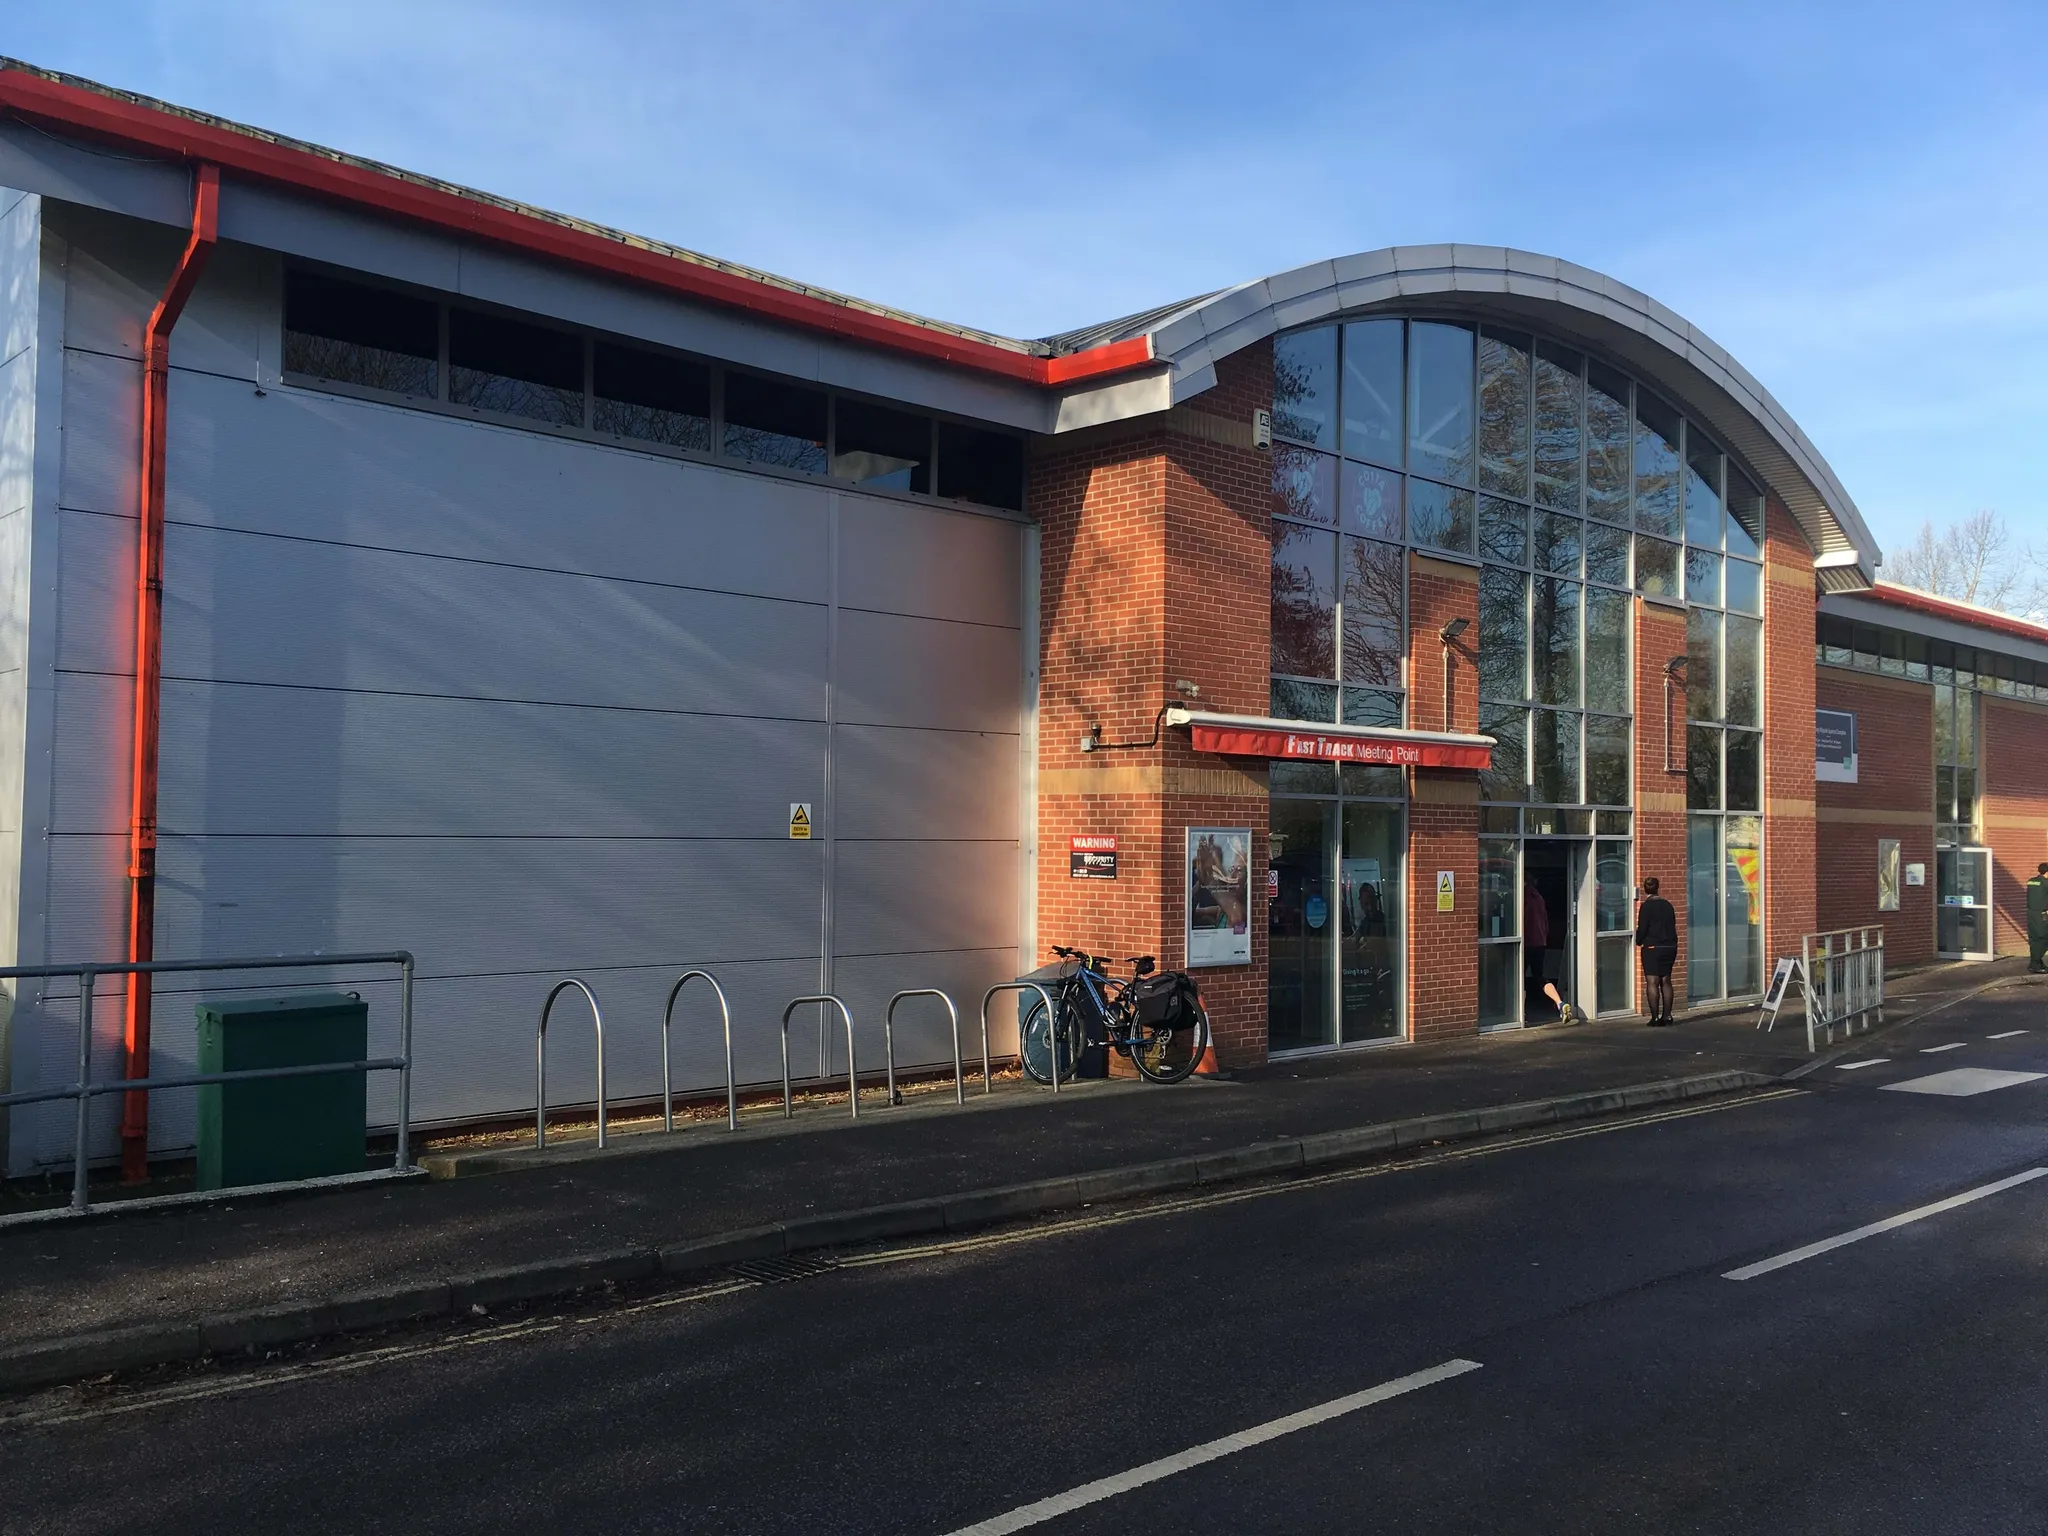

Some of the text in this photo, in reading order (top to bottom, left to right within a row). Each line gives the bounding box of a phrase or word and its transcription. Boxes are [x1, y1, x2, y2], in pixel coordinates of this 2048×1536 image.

[1287, 735, 1419, 763] FAST TRACK Meeting Point
[1072, 837, 1116, 849] WARNING
